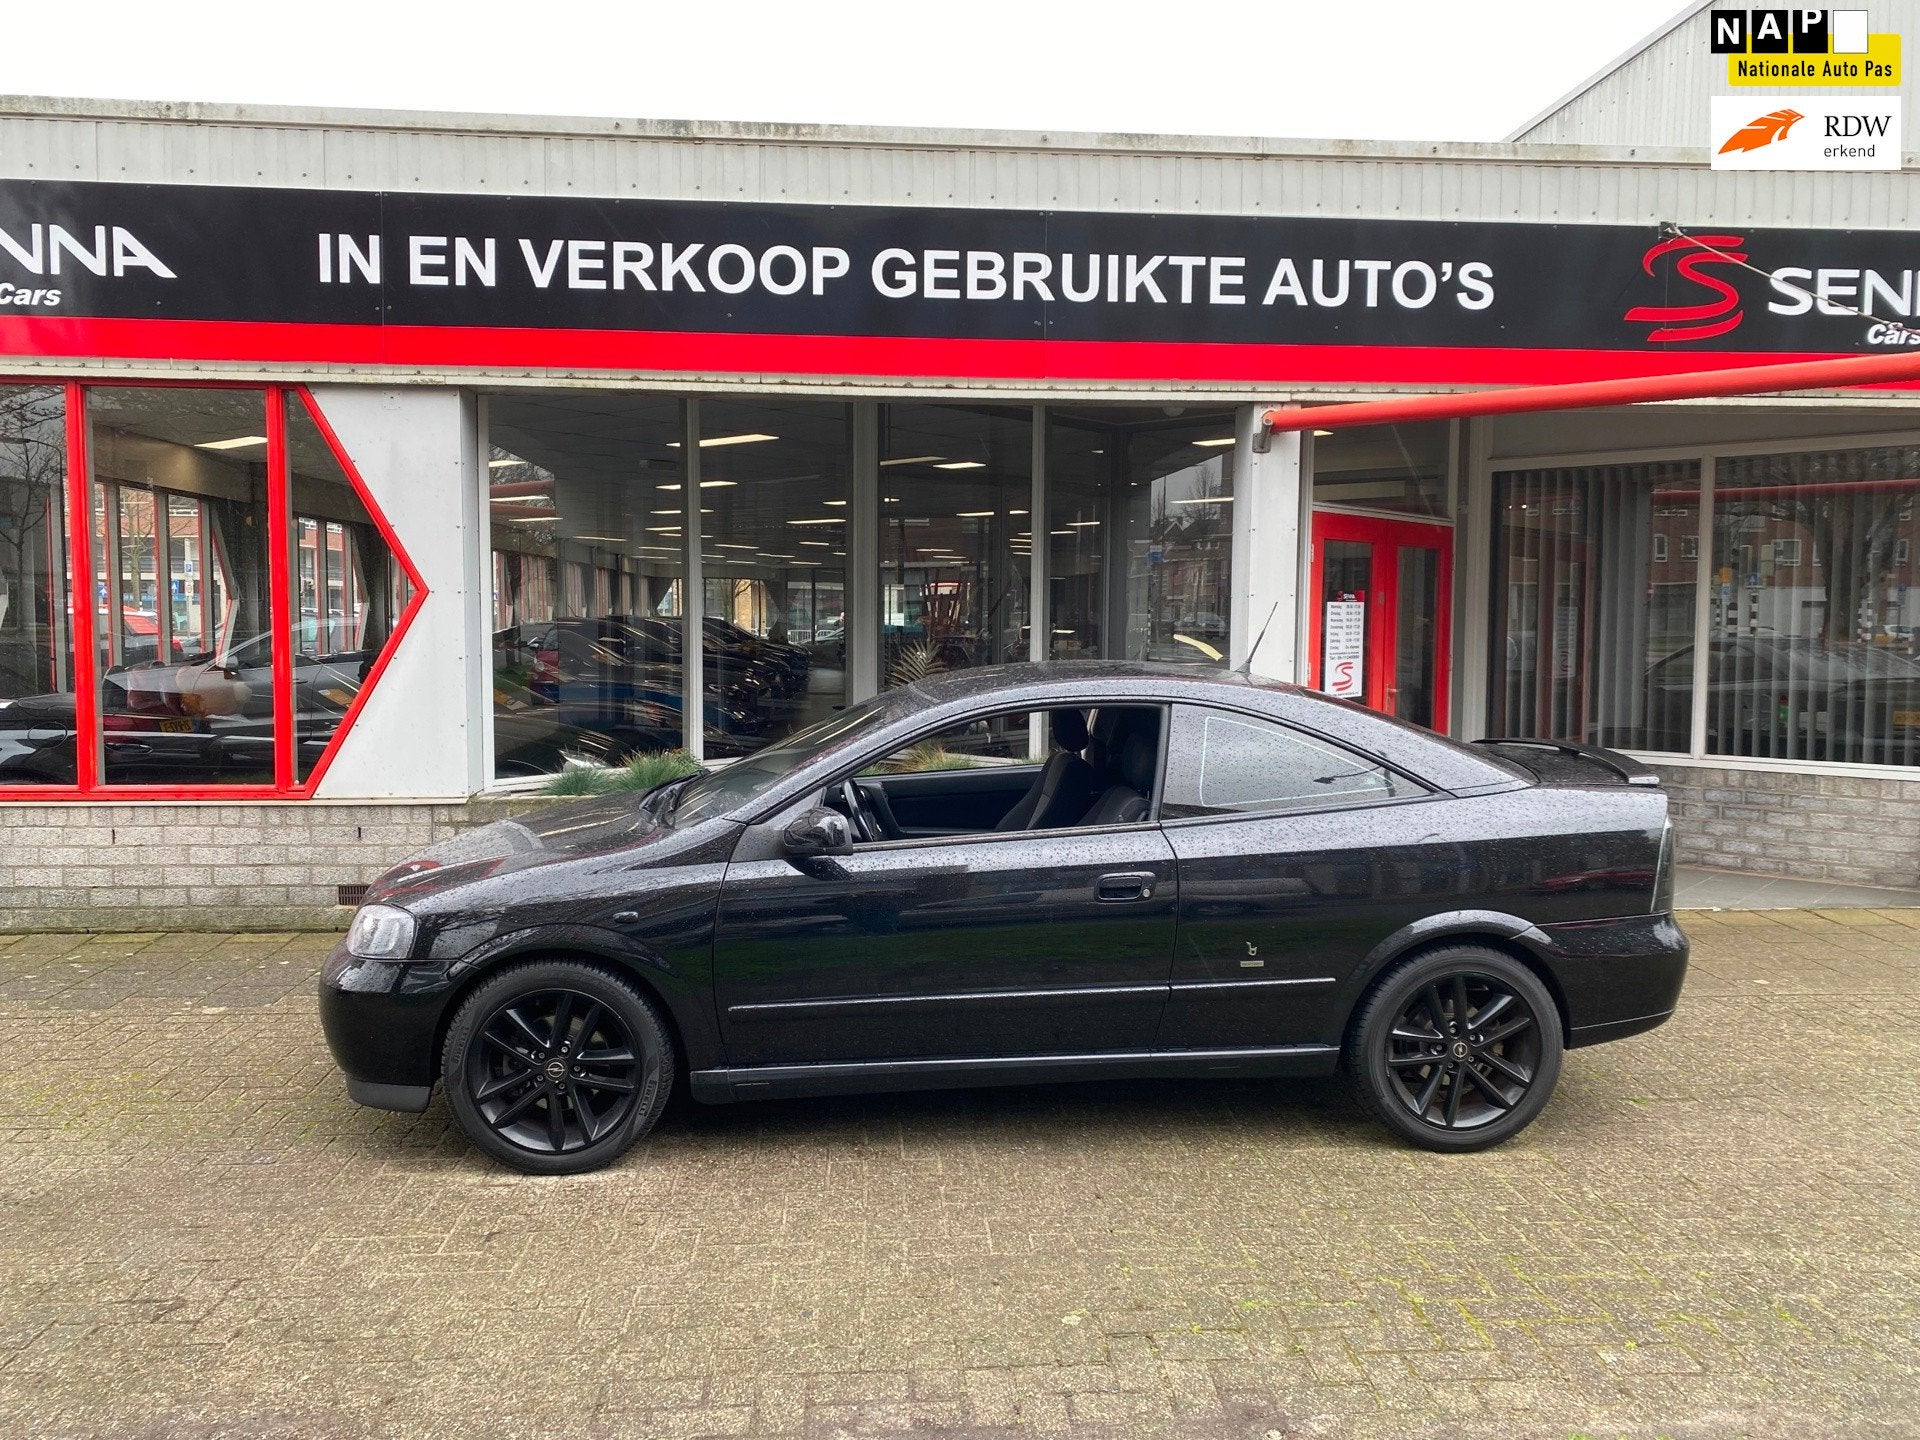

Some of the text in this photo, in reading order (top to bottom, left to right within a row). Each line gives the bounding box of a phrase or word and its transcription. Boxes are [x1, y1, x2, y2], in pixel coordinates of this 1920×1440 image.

[0, 282, 62, 306] Cars
[318, 233, 1495, 311] IN EN VERKOOP GEBRUIKTE AUTO’S
[1767, 266, 1920, 317] SEN
